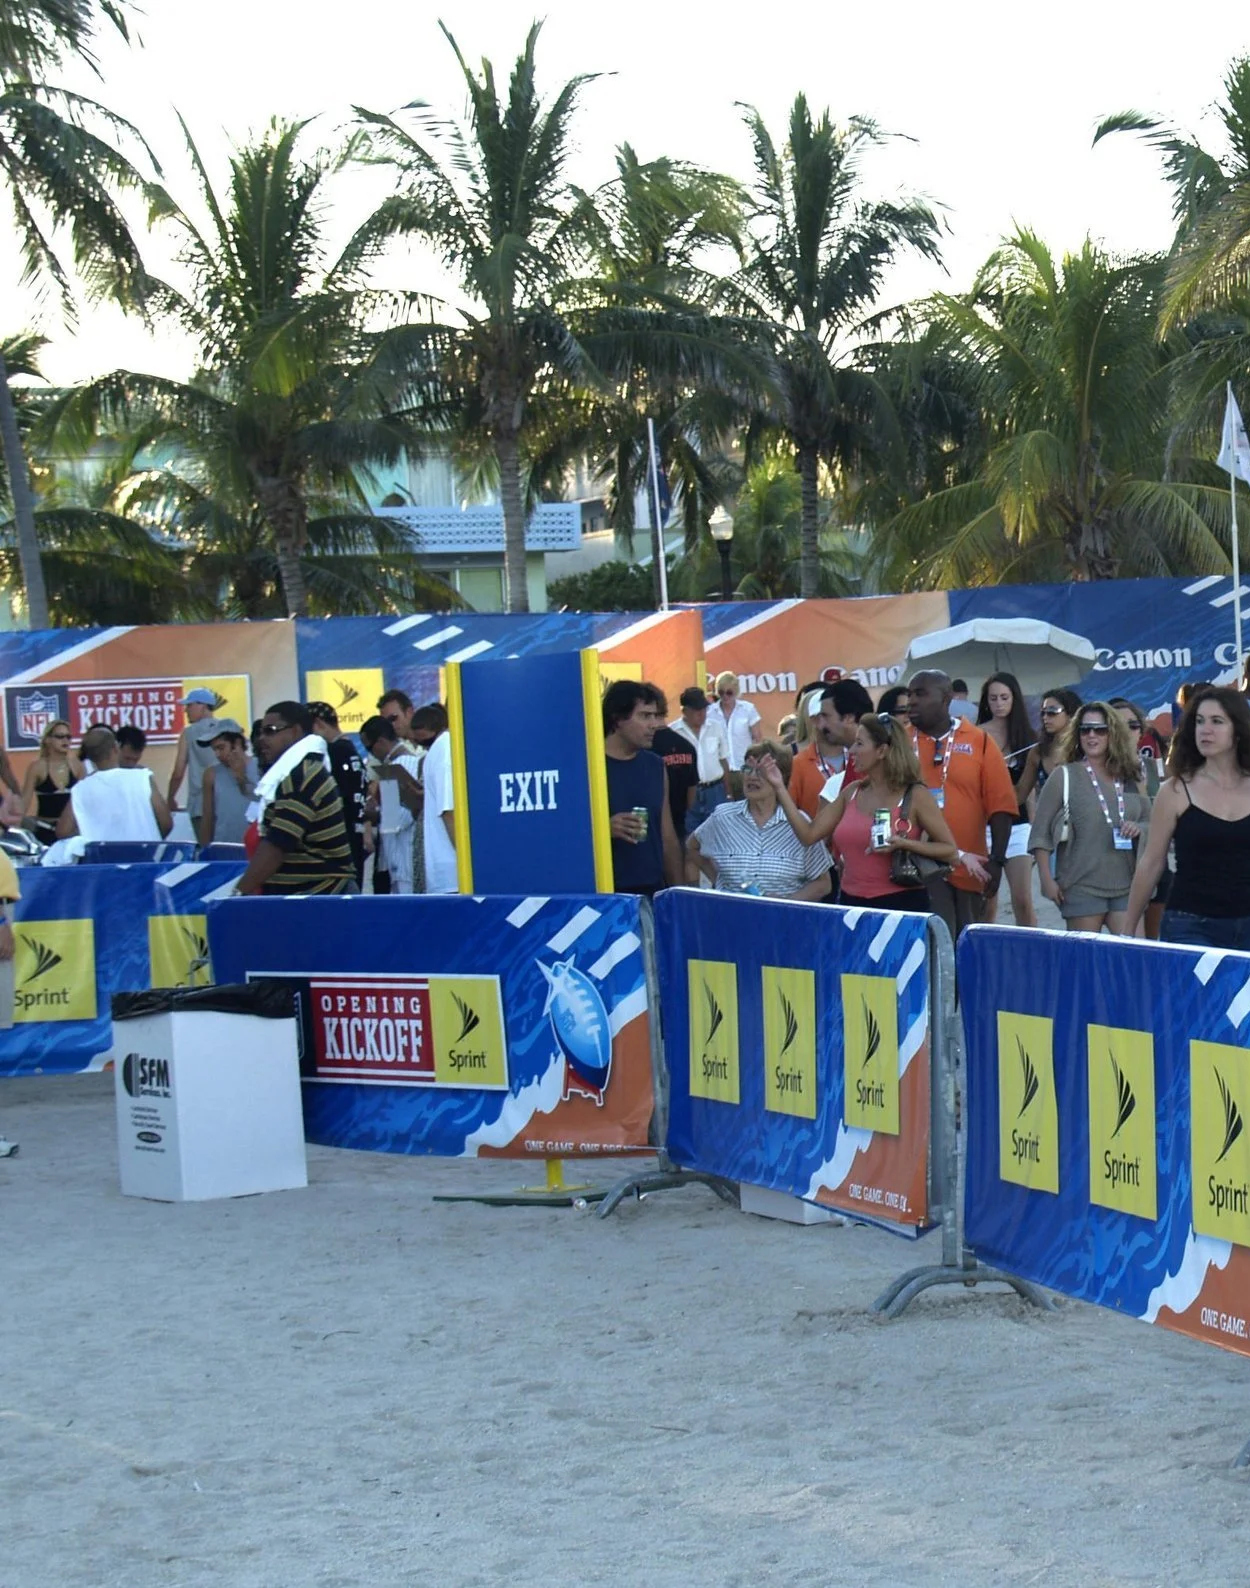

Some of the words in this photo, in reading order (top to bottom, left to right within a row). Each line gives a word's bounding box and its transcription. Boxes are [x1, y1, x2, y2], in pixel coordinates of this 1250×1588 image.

[1093, 647, 1192, 671] Canon
[820, 665, 907, 687] Cano
[77, 690, 175, 706] OPENING
[78, 704, 176, 734] KICKOFF
[499, 769, 559, 813] EXIT
[14, 987, 69, 1011] Sprint
[320, 995, 422, 1014] OPENING
[323, 1017, 423, 1063] KICKOFF
[140, 1057, 170, 1088] SFM
[449, 1049, 487, 1072] Sprint
[702, 1054, 729, 1083] Sprint
[775, 1066, 804, 1097] Sprint
[856, 1079, 886, 1111] Sprint
[1012, 1129, 1041, 1164] Sprint
[1104, 1150, 1141, 1188] Sprint
[1208, 1175, 1250, 1216] Sprint
[1200, 1307, 1219, 1329] ONE
[1219, 1313, 1248, 1339] GAME.
